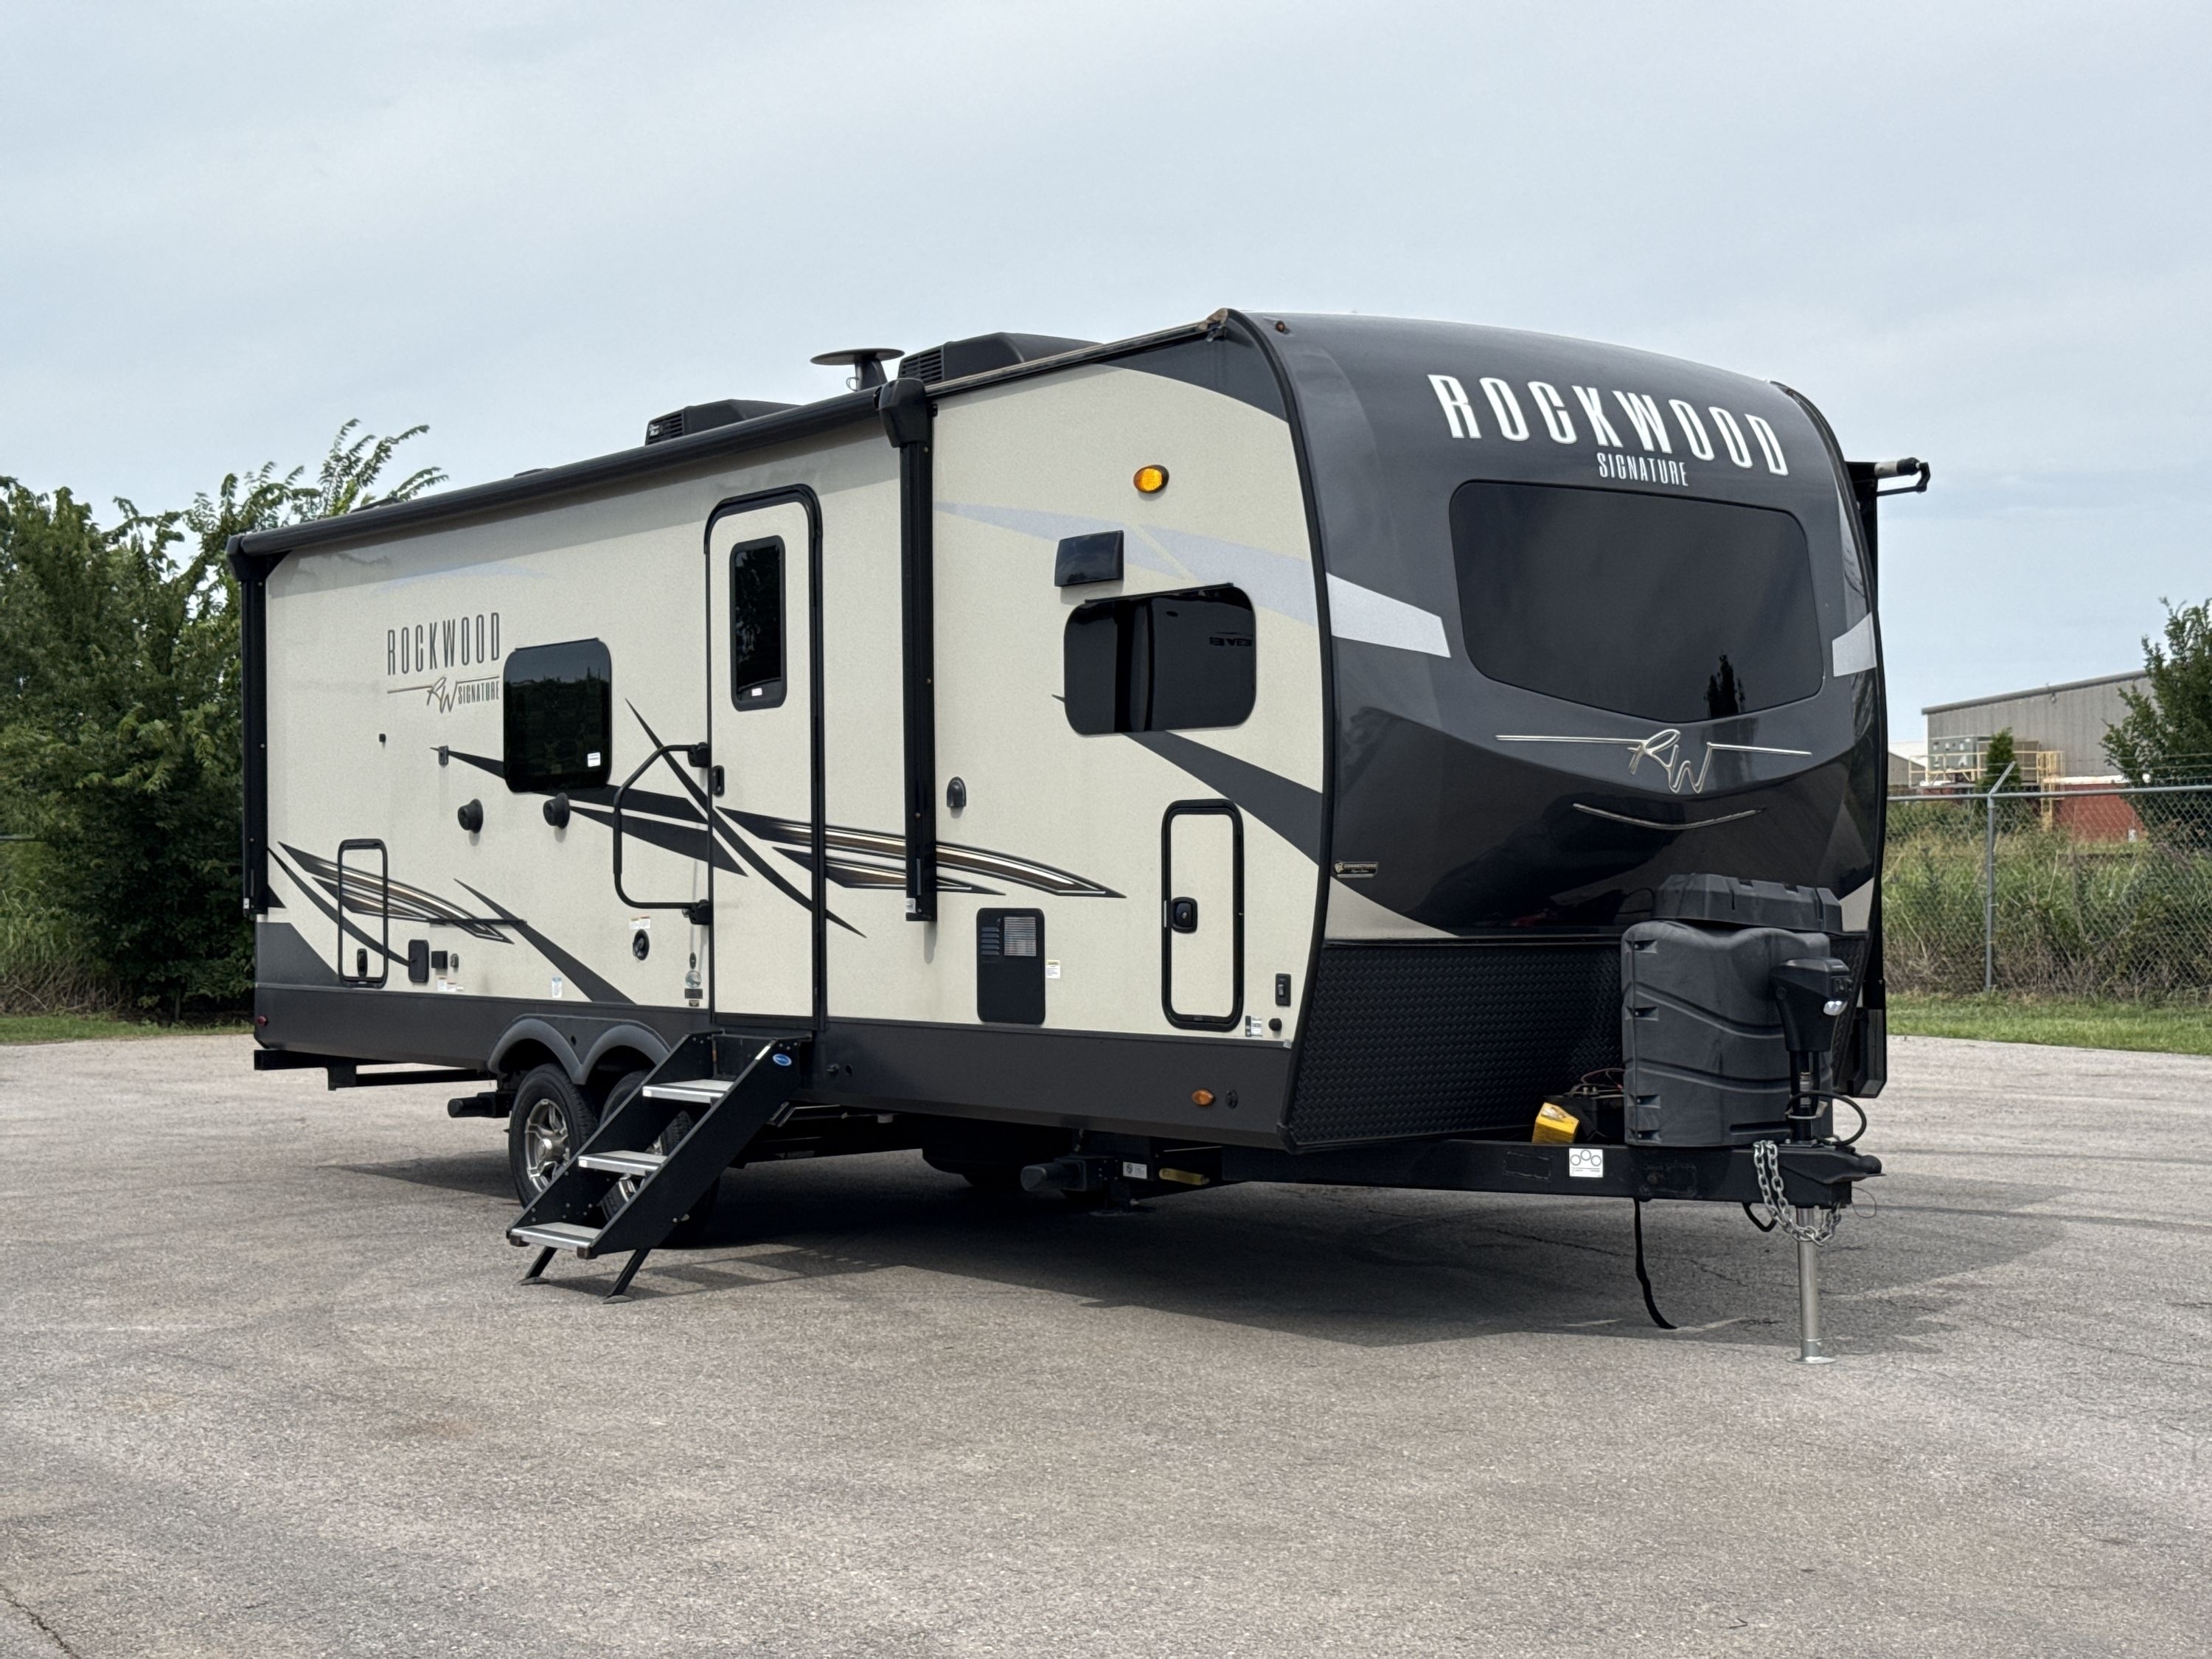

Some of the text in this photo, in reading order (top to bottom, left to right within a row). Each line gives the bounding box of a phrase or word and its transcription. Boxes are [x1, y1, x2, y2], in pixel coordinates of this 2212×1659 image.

[1427, 374, 1789, 476] ROCKWOOD
[1596, 452, 1689, 487] SIGNATURE
[387, 612, 500, 676] ROCKWOOD
[458, 681, 500, 705] SIGNATURE
